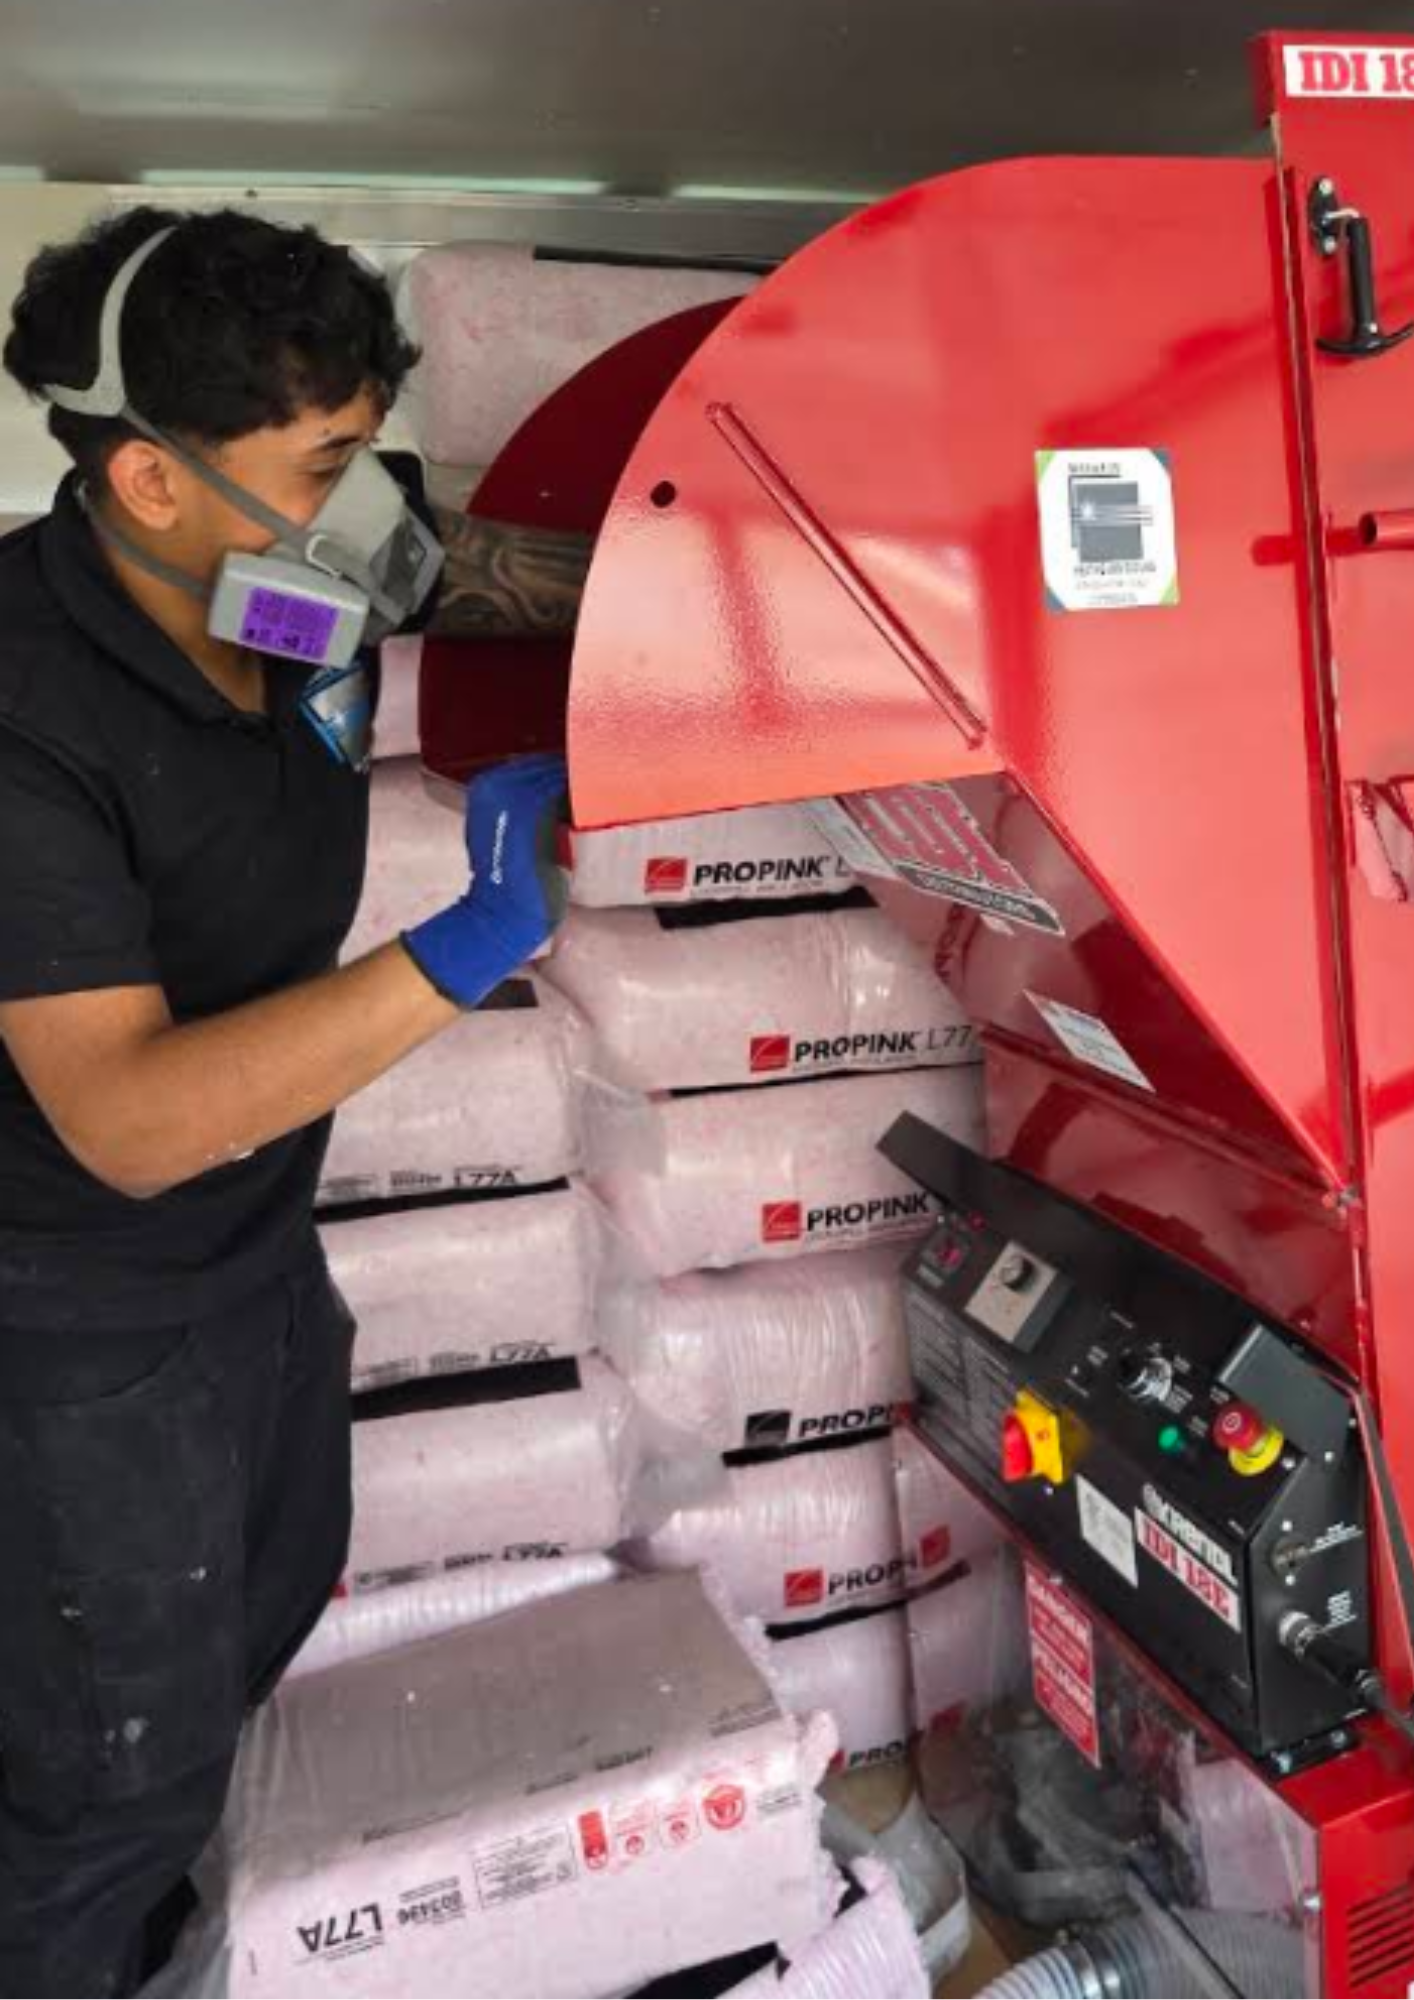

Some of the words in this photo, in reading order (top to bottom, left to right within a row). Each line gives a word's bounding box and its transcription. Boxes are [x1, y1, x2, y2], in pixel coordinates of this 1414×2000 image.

[1299, 51, 1370, 92] IDI
[693, 856, 824, 887] PROPINK
[795, 1032, 915, 1063] PROPINK
[807, 1193, 929, 1232] PROPINK
[799, 1404, 890, 1438] PROP
[829, 1560, 906, 1596] PROP
[296, 1901, 384, 1953] L77A
